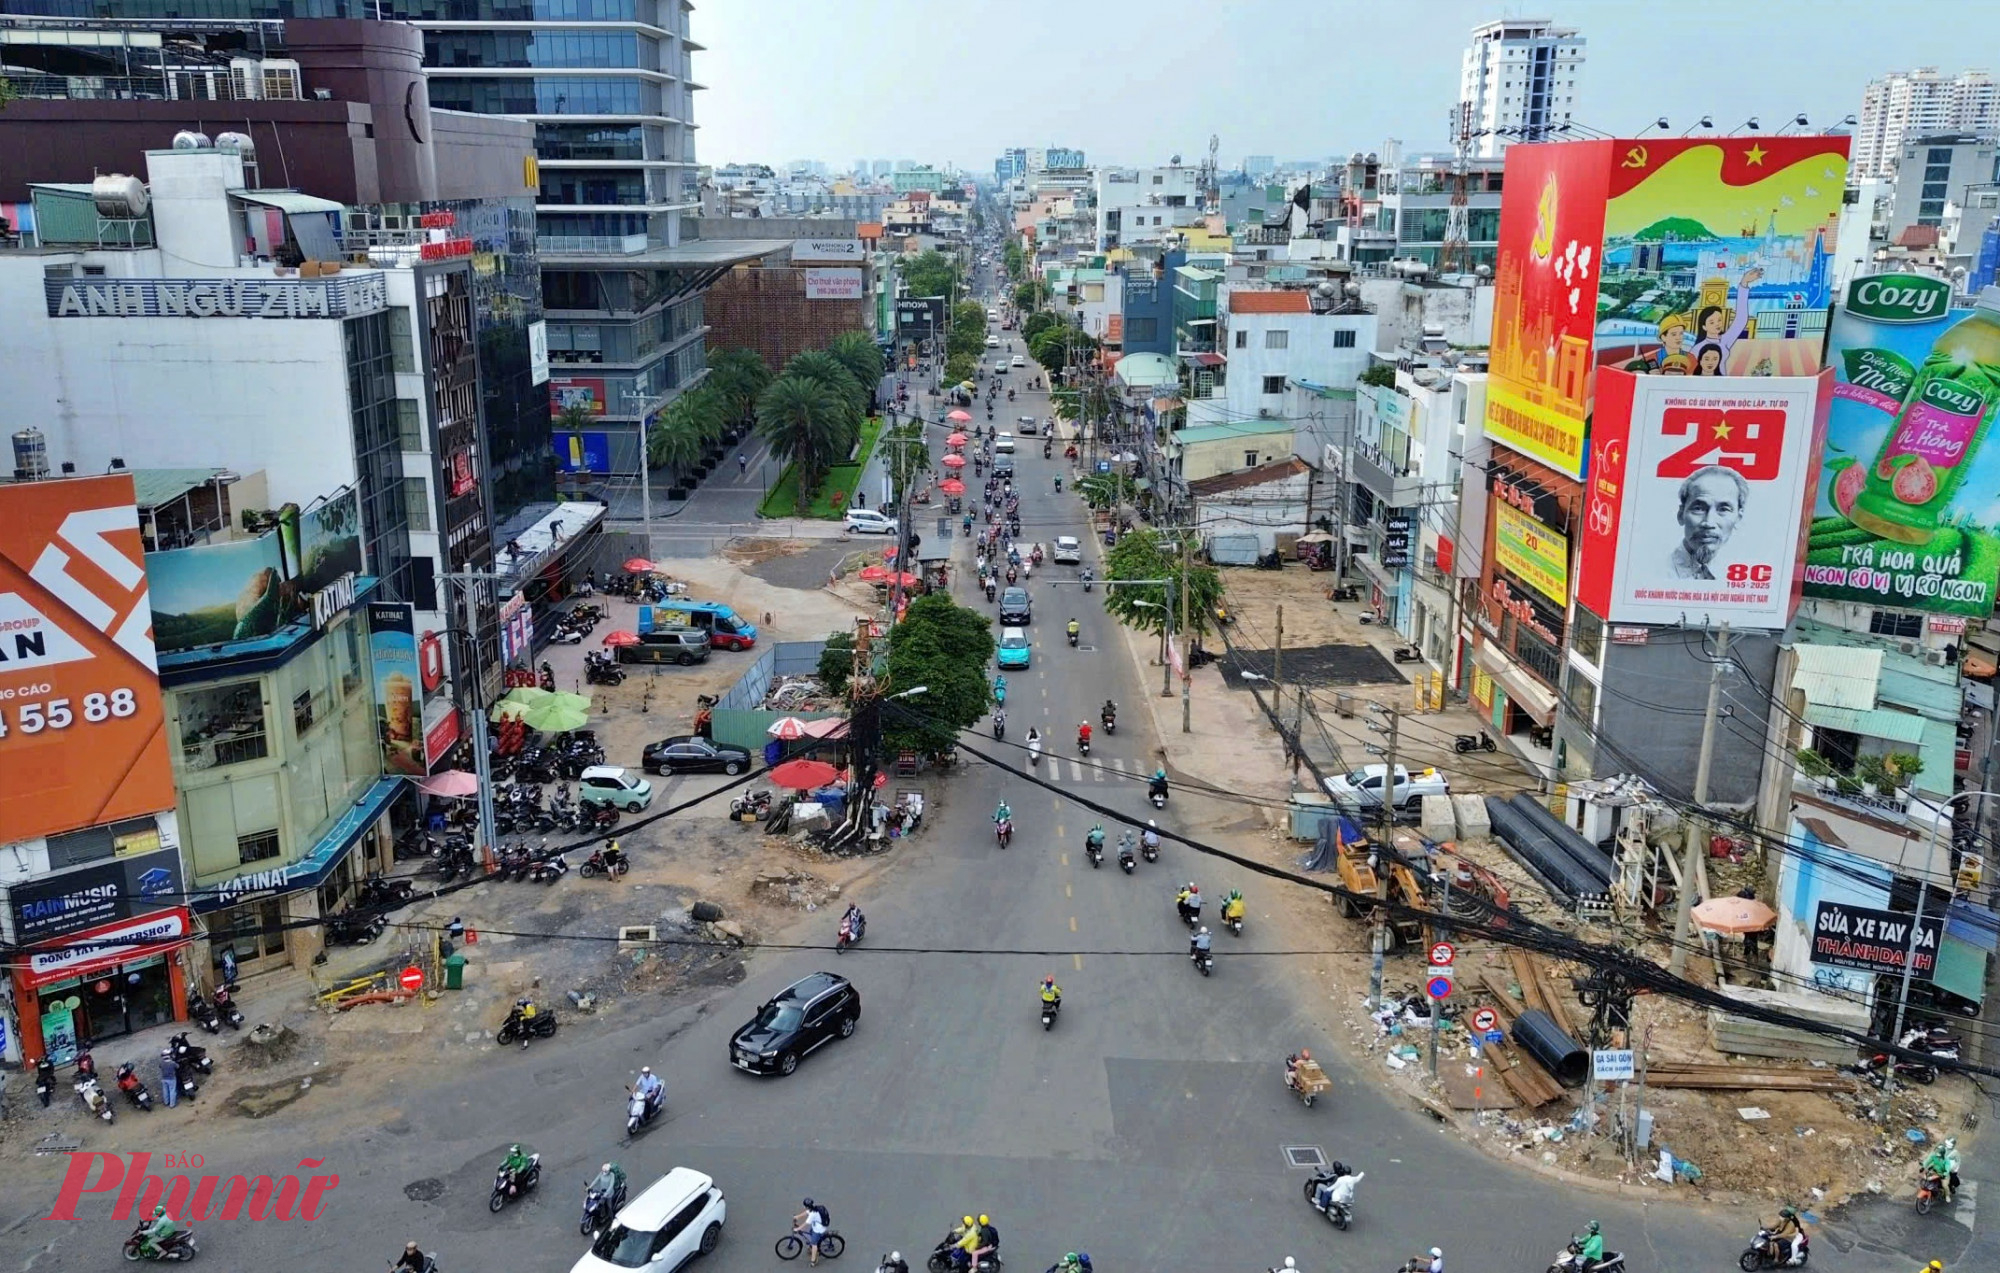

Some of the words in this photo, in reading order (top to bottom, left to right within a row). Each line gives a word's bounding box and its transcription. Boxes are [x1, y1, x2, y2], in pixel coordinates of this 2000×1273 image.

[57, 285, 145, 316] ANH
[155, 277, 244, 316] NGỮ
[257, 285, 330, 316] ZIM
[1857, 281, 1938, 314] Cozy
[1851, 365, 1907, 395] Mới
[1850, 388, 1879, 405] không
[1926, 382, 1978, 412] Cozy
[1927, 419, 1950, 432] Trà
[1917, 430, 1964, 457] Hồng
[1389, 520, 1408, 530] KÍNH
[1388, 537, 1405, 547] MẮT
[1842, 543, 1874, 566] TRÀ
[1880, 551, 1915, 570] HOA
[1922, 548, 1961, 576] QUẢ
[1805, 565, 1846, 586] NGON
[1850, 567, 1872, 588] RÕ
[1873, 571, 1890, 594] VỊ
[1896, 575, 1914, 597] VỊ
[1916, 574, 1939, 595] RÕ
[1941, 580, 1986, 603] NGON
[314, 571, 356, 631] KATINAT
[376, 611, 404, 620] KATINAT
[19, 698, 73, 734] 55
[83, 688, 136, 722] 88
[218, 866, 290, 902] KATINAT
[1818, 906, 1849, 935] SỬA
[1853, 917, 1876, 939] XE
[1879, 921, 1907, 943] TAY
[1596, 1054, 1605, 1063] GA
